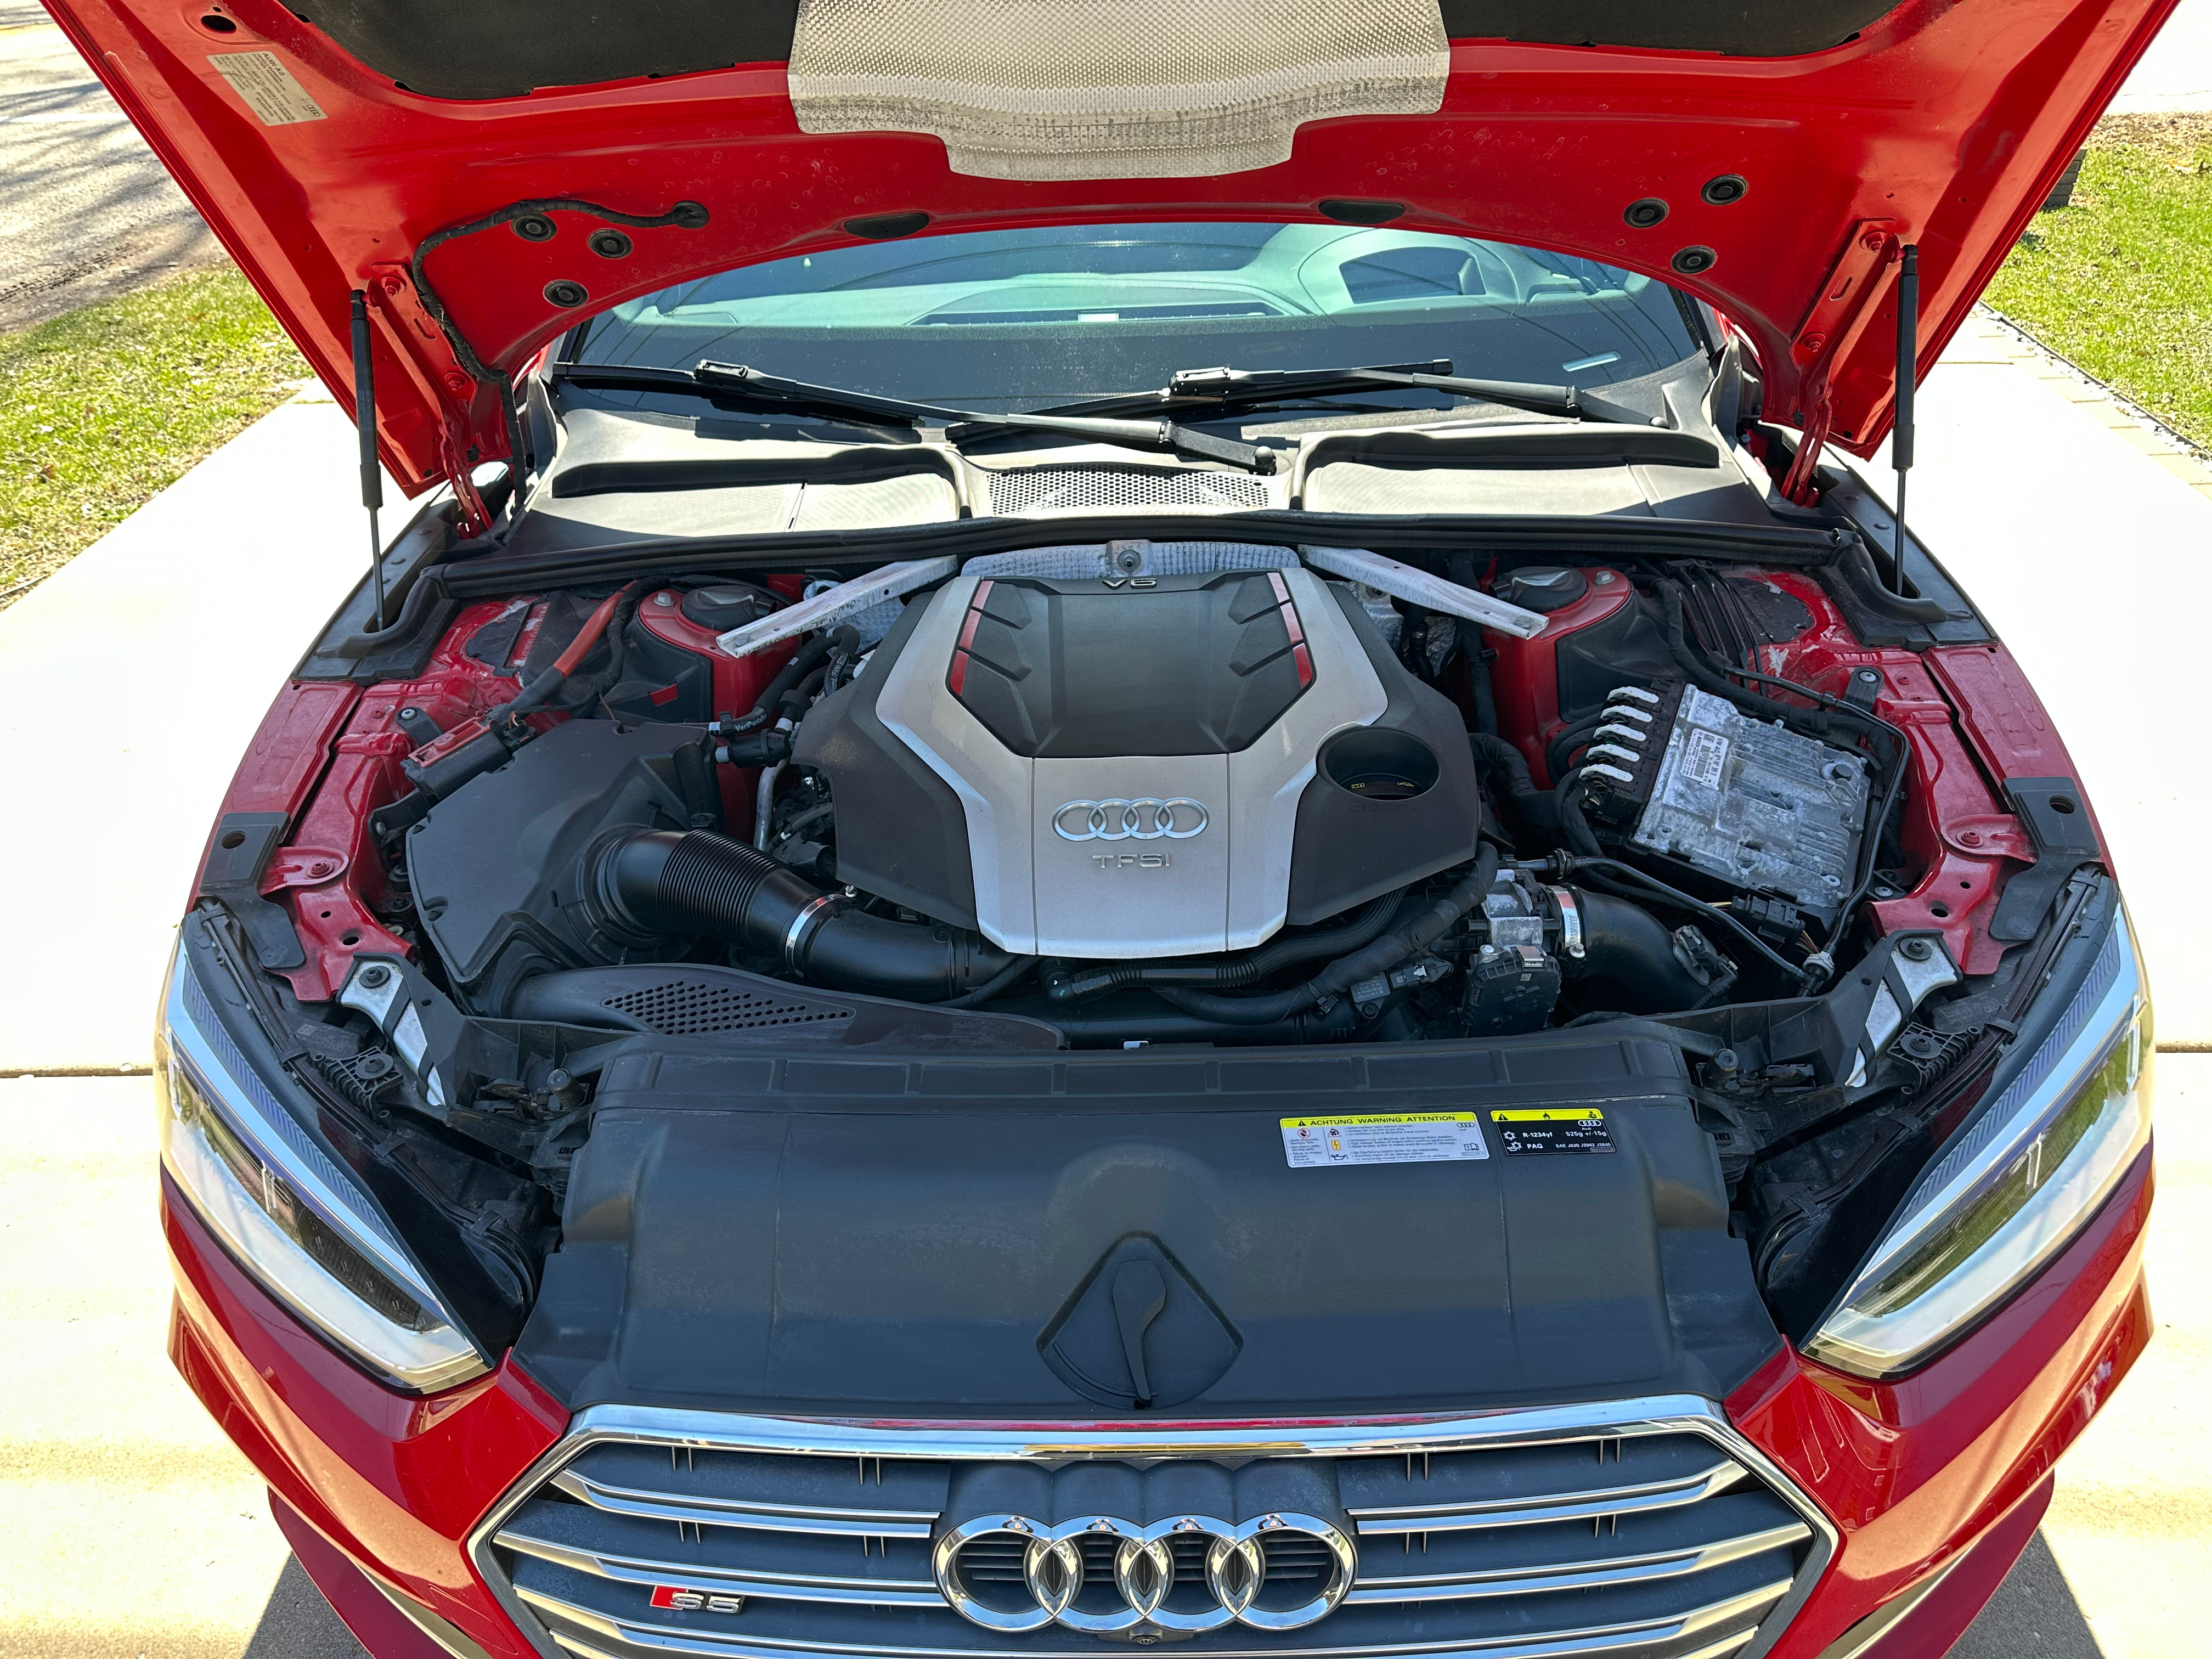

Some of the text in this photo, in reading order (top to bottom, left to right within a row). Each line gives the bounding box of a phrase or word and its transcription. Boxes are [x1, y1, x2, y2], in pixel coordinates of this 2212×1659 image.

[261, 53, 286, 75] AUDI AG
[1102, 578, 1157, 590] V6
[1716, 737, 1723, 746] VW
[1713, 745, 1721, 754] AG
[1092, 853, 1171, 868] TFSI
[670, 1590, 741, 1613] S5
